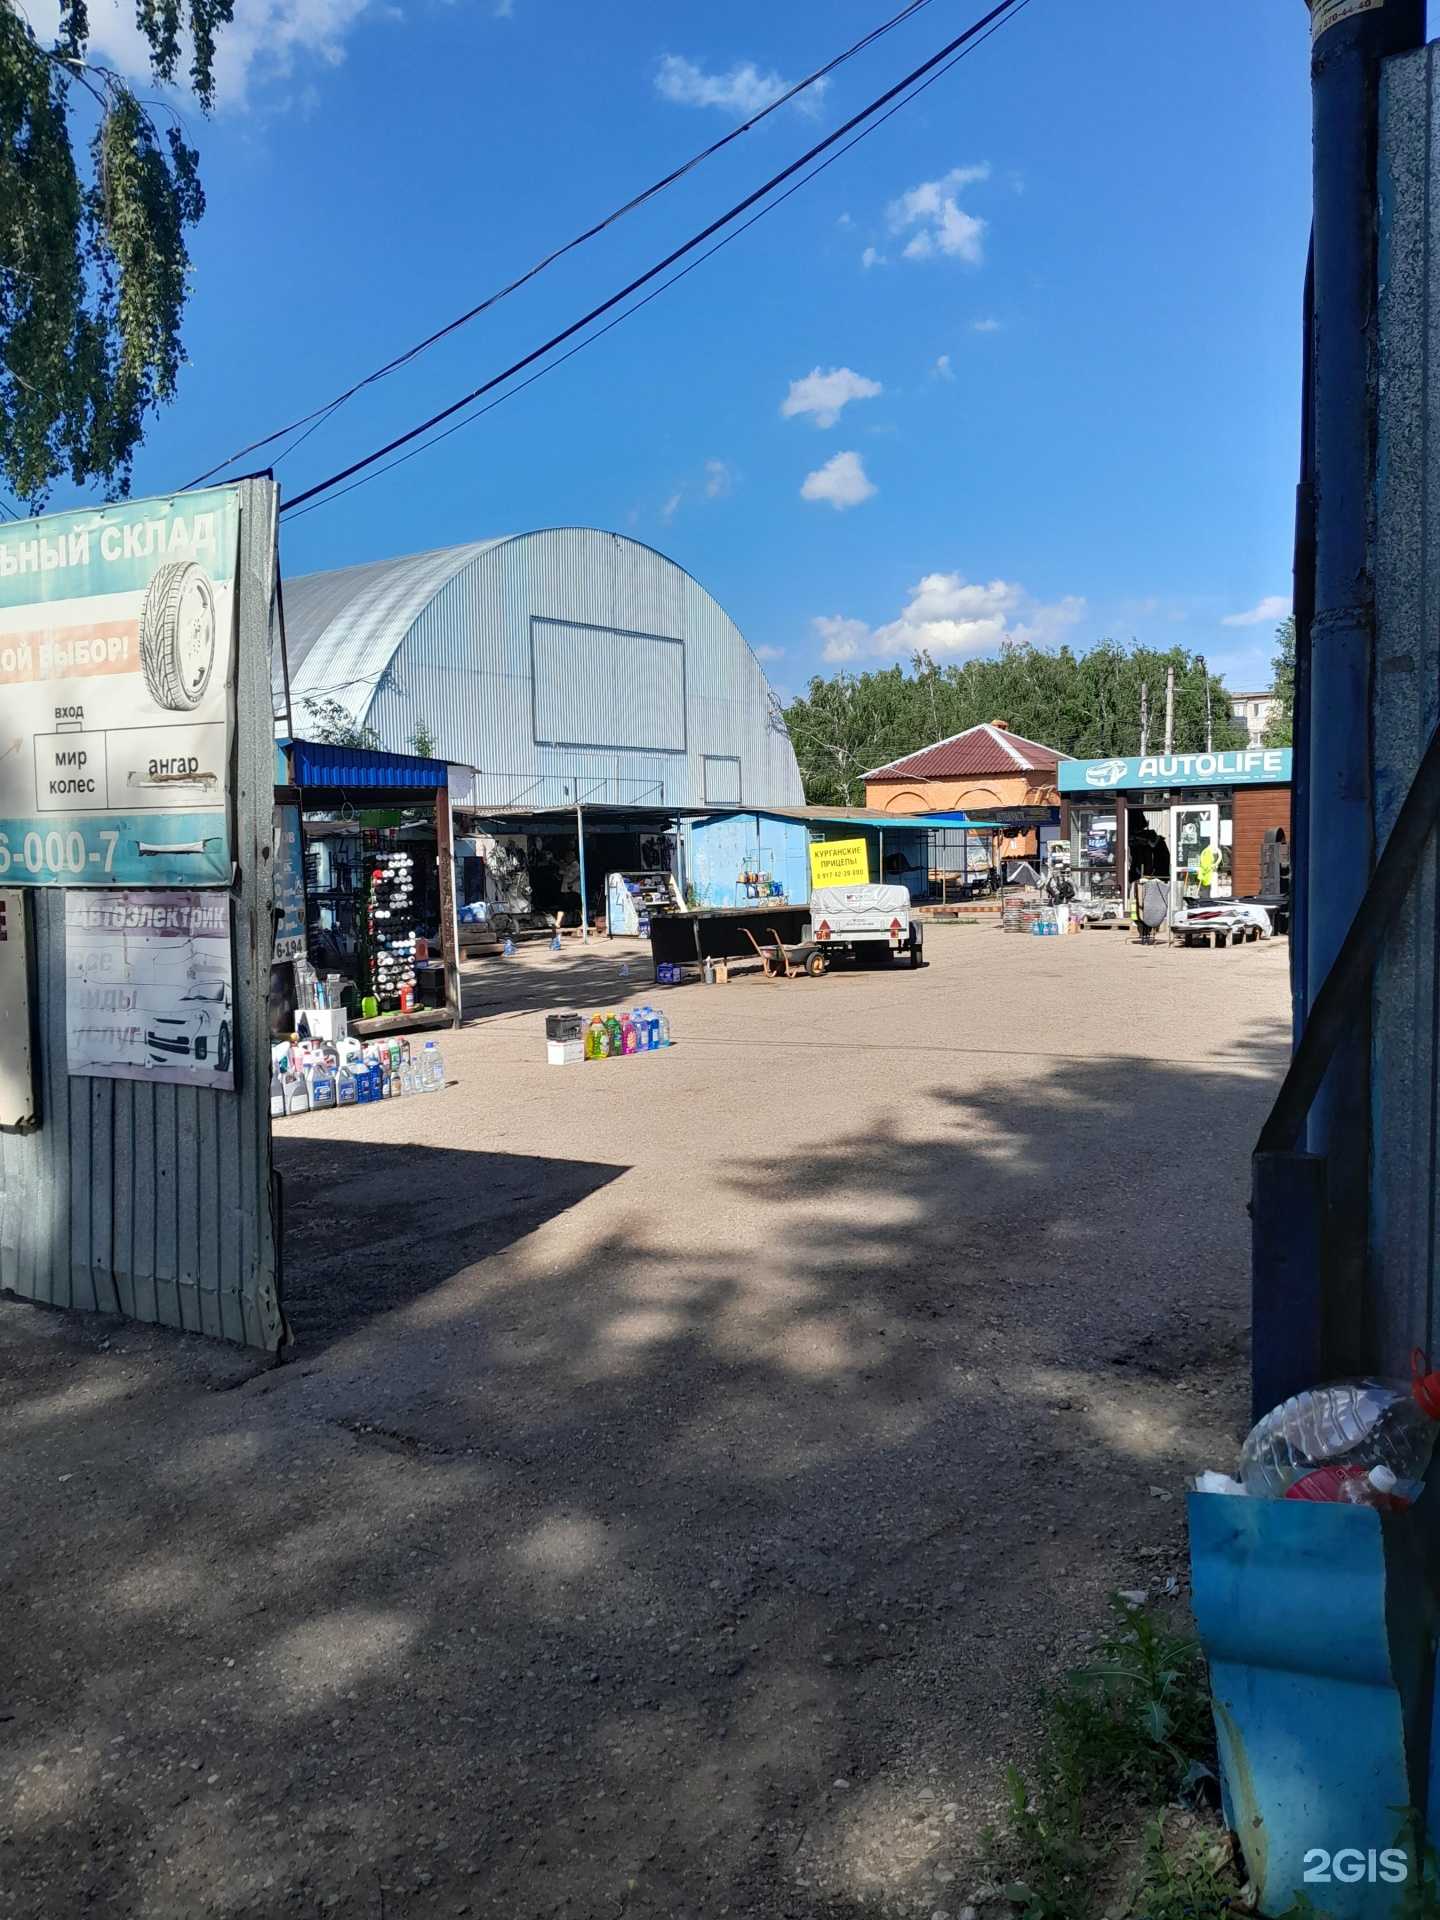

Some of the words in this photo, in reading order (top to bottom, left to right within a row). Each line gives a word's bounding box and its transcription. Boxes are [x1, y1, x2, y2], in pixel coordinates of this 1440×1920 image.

[101, 512, 216, 561] СКЛАД
[39, 635, 129, 675] ВЫБОР!
[55, 704, 84, 719] вход
[55, 750, 88, 769] мир
[148, 756, 199, 775] ангар
[1138, 751, 1283, 778] AUTOLIFE
[49, 777, 96, 794] колес
[814, 846, 862, 858] КУРГАНСКИЕ
[820, 857, 858, 869] ПРИЦЕПЫ
